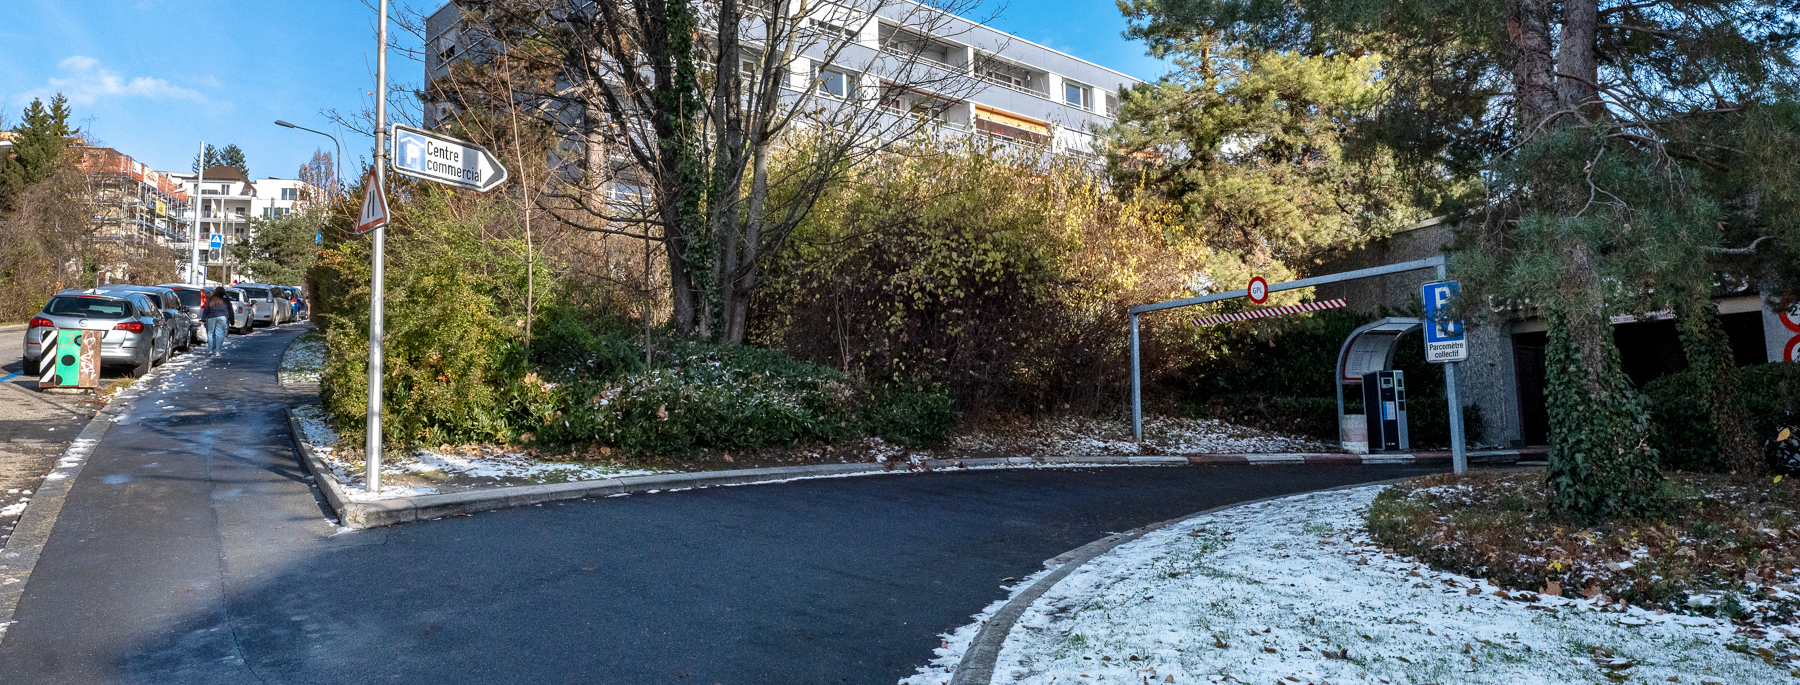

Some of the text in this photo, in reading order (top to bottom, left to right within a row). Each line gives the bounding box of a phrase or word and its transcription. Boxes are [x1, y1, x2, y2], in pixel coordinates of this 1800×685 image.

[427, 141, 459, 162] Centre
[427, 160, 482, 182] commercial
[1429, 342, 1464, 351] Parcomètre
[1435, 350, 1459, 358] collectif
